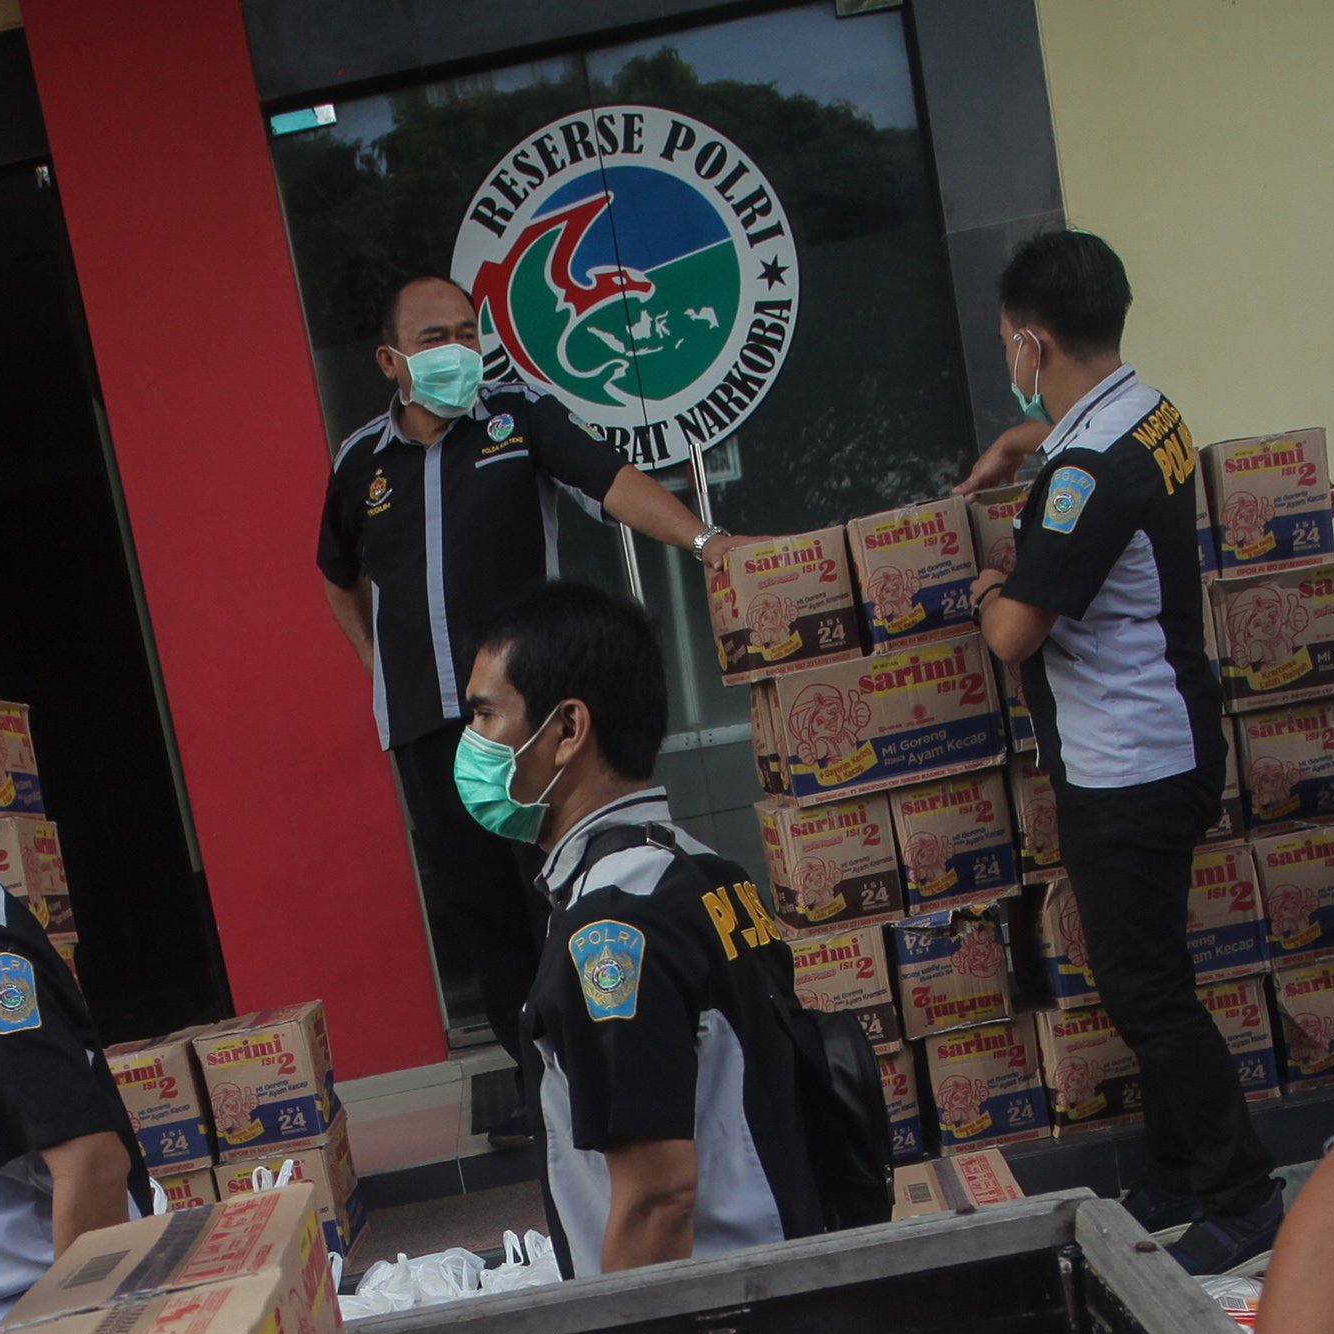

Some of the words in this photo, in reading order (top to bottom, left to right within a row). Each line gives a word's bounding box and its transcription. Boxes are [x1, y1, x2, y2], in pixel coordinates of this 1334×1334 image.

[470, 112, 644, 239] RESERSE
[660, 118, 786, 248] POLRI
[674, 297, 793, 445] NARKOBA
[1224, 442, 1306, 474] sarimi
[1052, 471, 1091, 490] POLRI
[1282, 466, 1296, 476] ISI
[1297, 462, 1317, 487] 2
[865, 511, 946, 551] sarimi
[1293, 527, 1321, 546] 24
[924, 536, 938, 548] ISI
[940, 532, 960, 556] 2
[745, 540, 825, 574] sarimi
[803, 563, 817, 574] ISI
[819, 558, 838, 583] 2
[941, 595, 968, 615] 24
[817, 624, 846, 644] 24
[1317, 651, 1331, 664] Mi
[857, 646, 969, 696] sarimi
[937, 679, 957, 694] ISI
[959, 672, 987, 706] 2
[1247, 708, 1328, 740] sarimi
[881, 742, 897, 757] Mi
[899, 727, 947, 750] Goreng
[884, 754, 905, 767] Rasa
[907, 744, 944, 767] Ayam
[946, 731, 987, 752] Kecap
[902, 785, 982, 816] sarimi
[959, 804, 973, 815] ISI
[975, 800, 994, 823] 2
[789, 804, 869, 838] sarimi
[846, 827, 860, 838] ISI
[863, 823, 881, 846] 2
[973, 860, 1001, 880] 24
[861, 887, 890, 906] 24
[1207, 888, 1227, 906] ISI
[1229, 880, 1255, 912] 2
[575, 930, 640, 952] POLRI
[794, 937, 862, 969] arimi
[1215, 938, 1255, 956] Kecap
[839, 960, 854, 972] ISI
[856, 956, 875, 980] 2
[1241, 1003, 1261, 1028] 2
[206, 1033, 283, 1066] sarimi
[937, 1026, 1015, 1060] sarimi
[261, 1057, 275, 1067] ISI
[277, 1052, 297, 1076] 2
[1008, 1045, 1026, 1068] 2
[1238, 1064, 1266, 1082] 24
[143, 1081, 157, 1091] ISI
[158, 1076, 178, 1100] 2
[893, 1074, 909, 1097] 2
[278, 1113, 307, 1130] 24
[1007, 1104, 1035, 1122] 24
[160, 1135, 189, 1153] 24
[893, 1132, 915, 1150] 24
